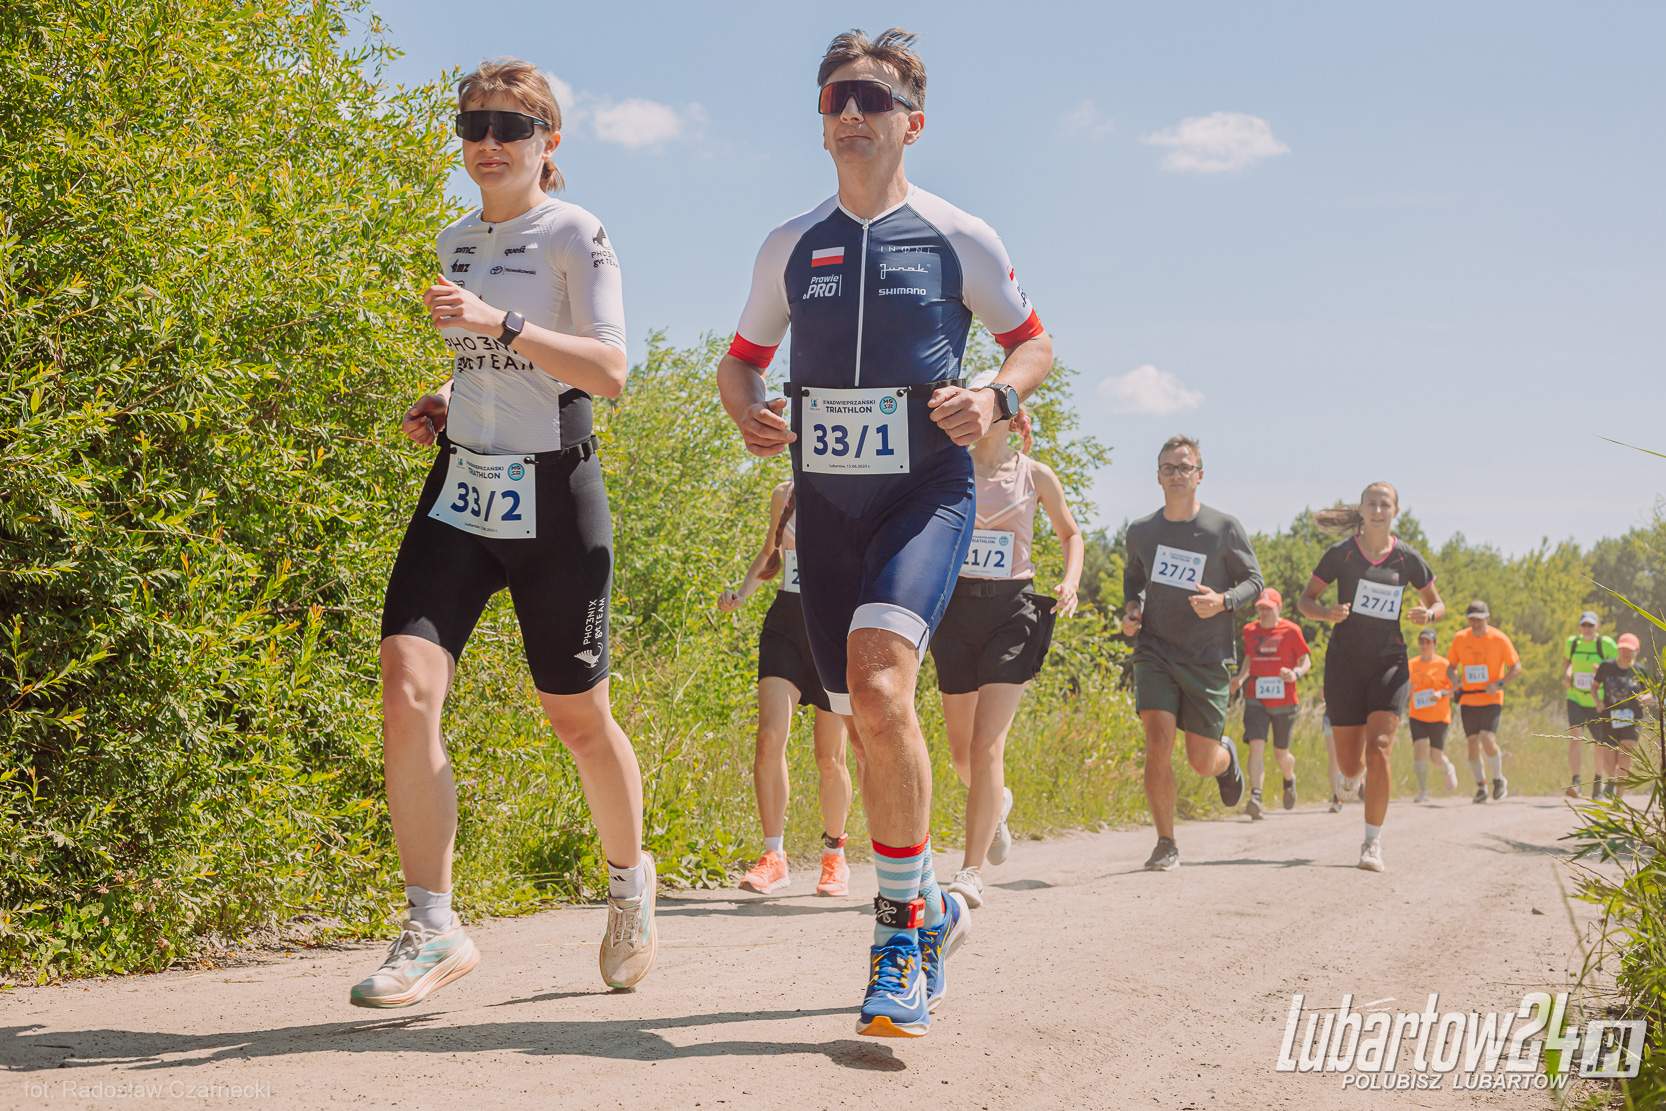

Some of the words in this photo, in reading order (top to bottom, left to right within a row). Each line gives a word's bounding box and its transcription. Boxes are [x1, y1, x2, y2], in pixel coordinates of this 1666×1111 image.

[810, 274, 839, 284] Prowie
[878, 287, 927, 296] SHIMANO
[825, 406, 873, 414] TRIATHLON
[813, 424, 895, 458] 33/1
[450, 482, 522, 522] 33/2
[1158, 561, 1196, 582] 27/2
[1360, 595, 1395, 612] 27/1
